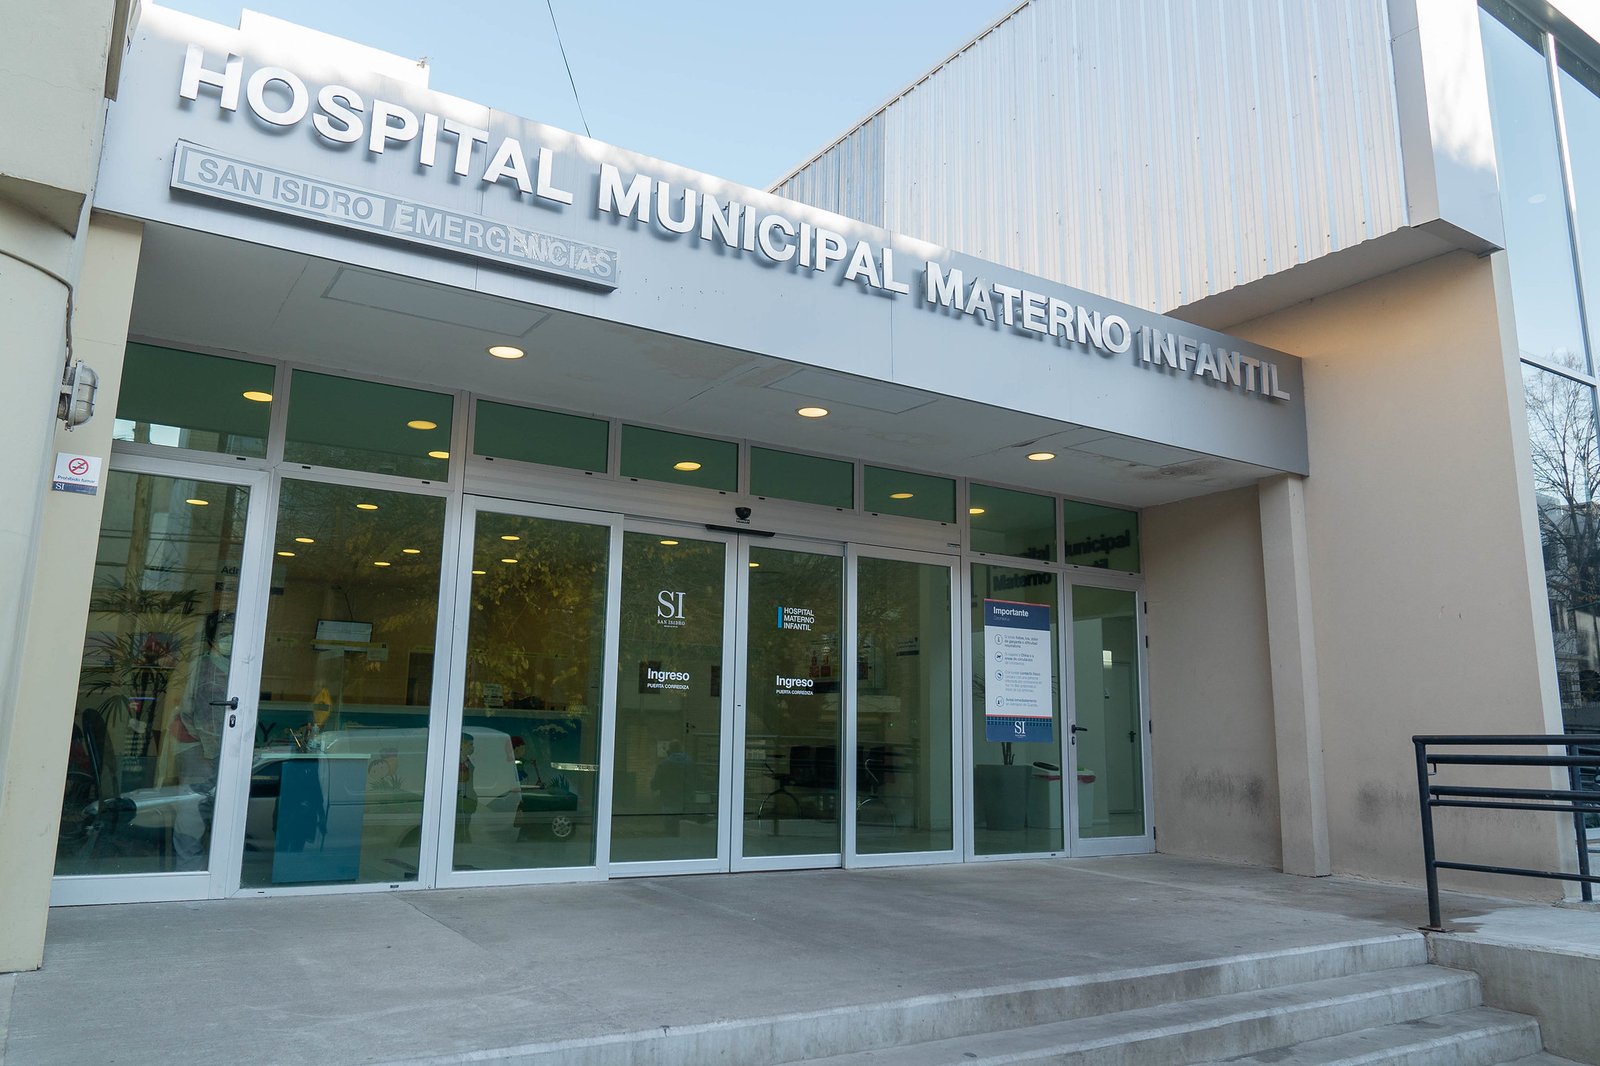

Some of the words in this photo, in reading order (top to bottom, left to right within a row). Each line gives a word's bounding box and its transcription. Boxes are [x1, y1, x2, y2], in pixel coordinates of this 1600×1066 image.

[179, 42, 574, 205] HOSPITAL
[598, 162, 910, 295] MUNICIPAL
[926, 260, 1132, 354] MATERNO
[1141, 324, 1291, 401] INFANTIL
[197, 158, 263, 196] SAN
[272, 176, 374, 220] ISIDRO
[394, 201, 612, 278] EMERGENCIAS
[55, 482, 65, 491] SI
[657, 590, 686, 619] SI
[783, 607, 815, 617] HOSPITAL
[993, 606, 1029, 618] Importante
[783, 615, 815, 624] MATERNO
[783, 622, 812, 631] INFANTIL
[647, 668, 690, 682] Ingreso
[776, 675, 814, 688] Ingreso
[1014, 721, 1026, 734] SI
